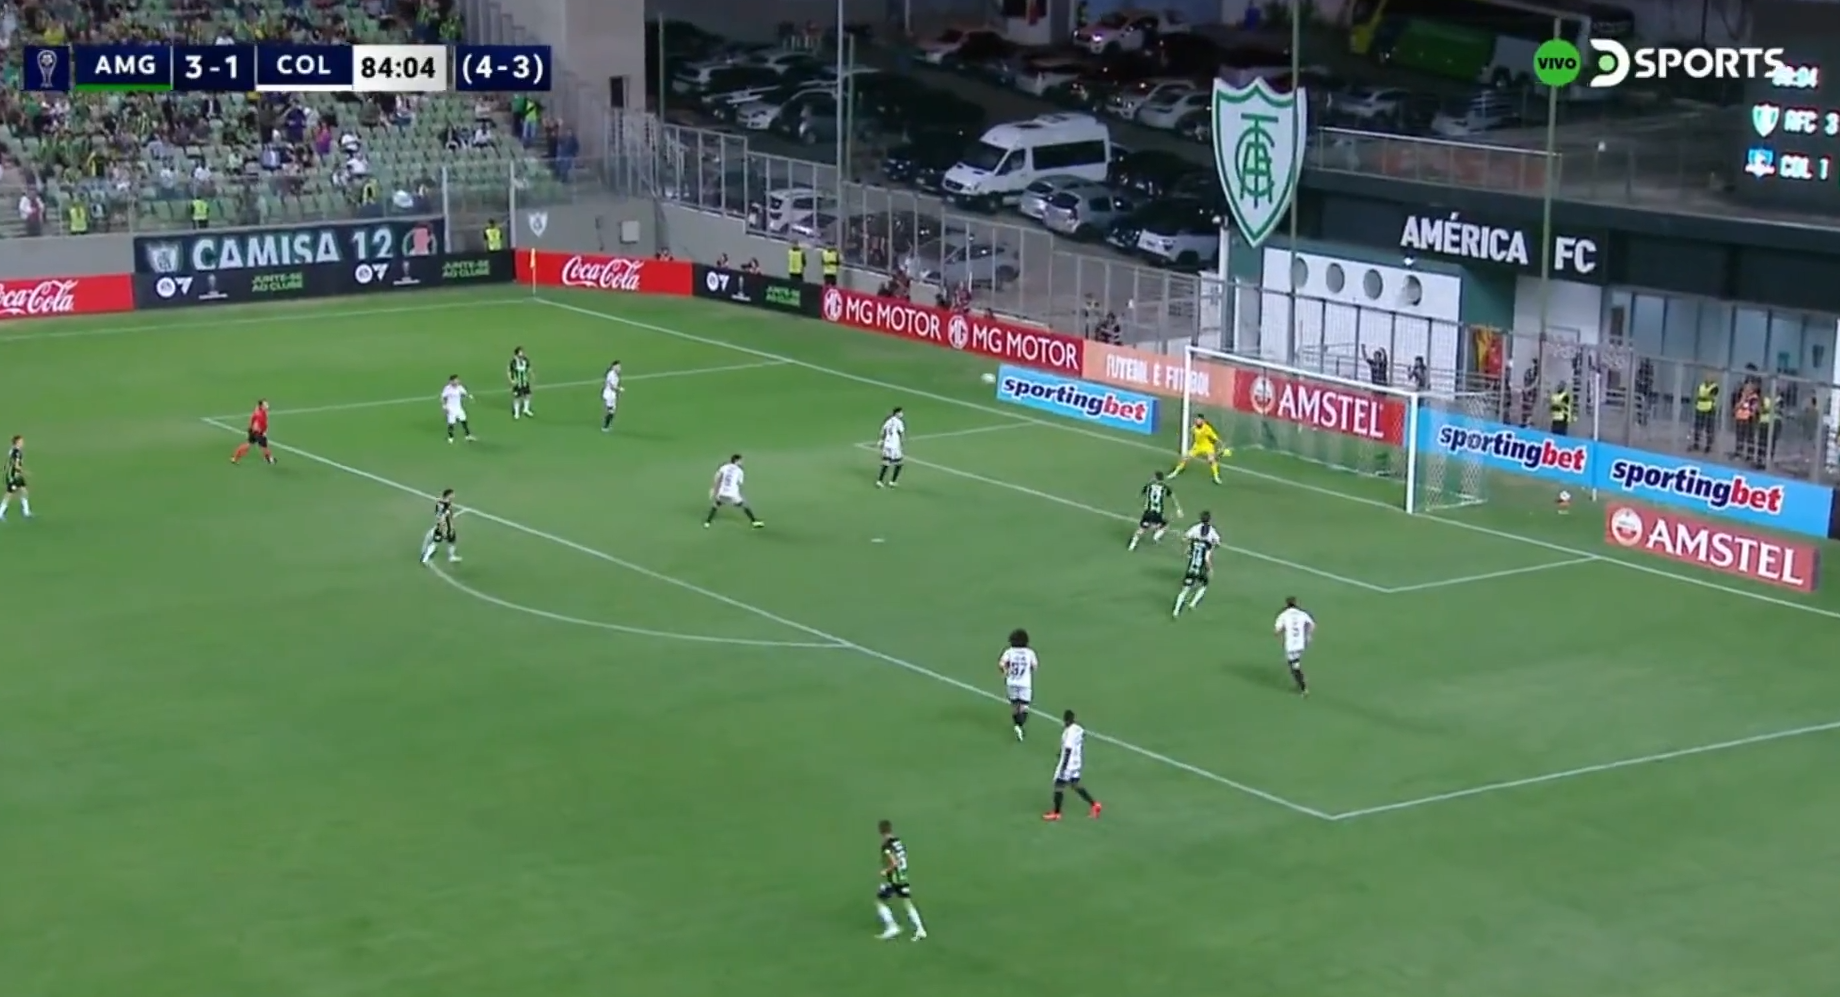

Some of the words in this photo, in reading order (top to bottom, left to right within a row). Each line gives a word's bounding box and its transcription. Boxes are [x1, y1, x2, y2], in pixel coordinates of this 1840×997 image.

[192, 228, 340, 271] CAMISA
[352, 228, 394, 260] 12
[1400, 212, 1529, 265] AMÉRICA
[1553, 236, 1598, 274] FC
[561, 255, 645, 291] Coca-Cola
[0, 279, 79, 315] ca-Cola
[846, 296, 873, 325] MG
[876, 303, 942, 341] MOTOR
[972, 323, 1002, 354] MG
[1006, 331, 1079, 370] MOTOR
[1003, 376, 1147, 424] sportingbet
[1277, 382, 1384, 438] AMSTEL
[1439, 426, 1586, 471] sportingbet
[1611, 459, 1784, 513] sportingbet
[1645, 518, 1804, 586] AMSTEL
